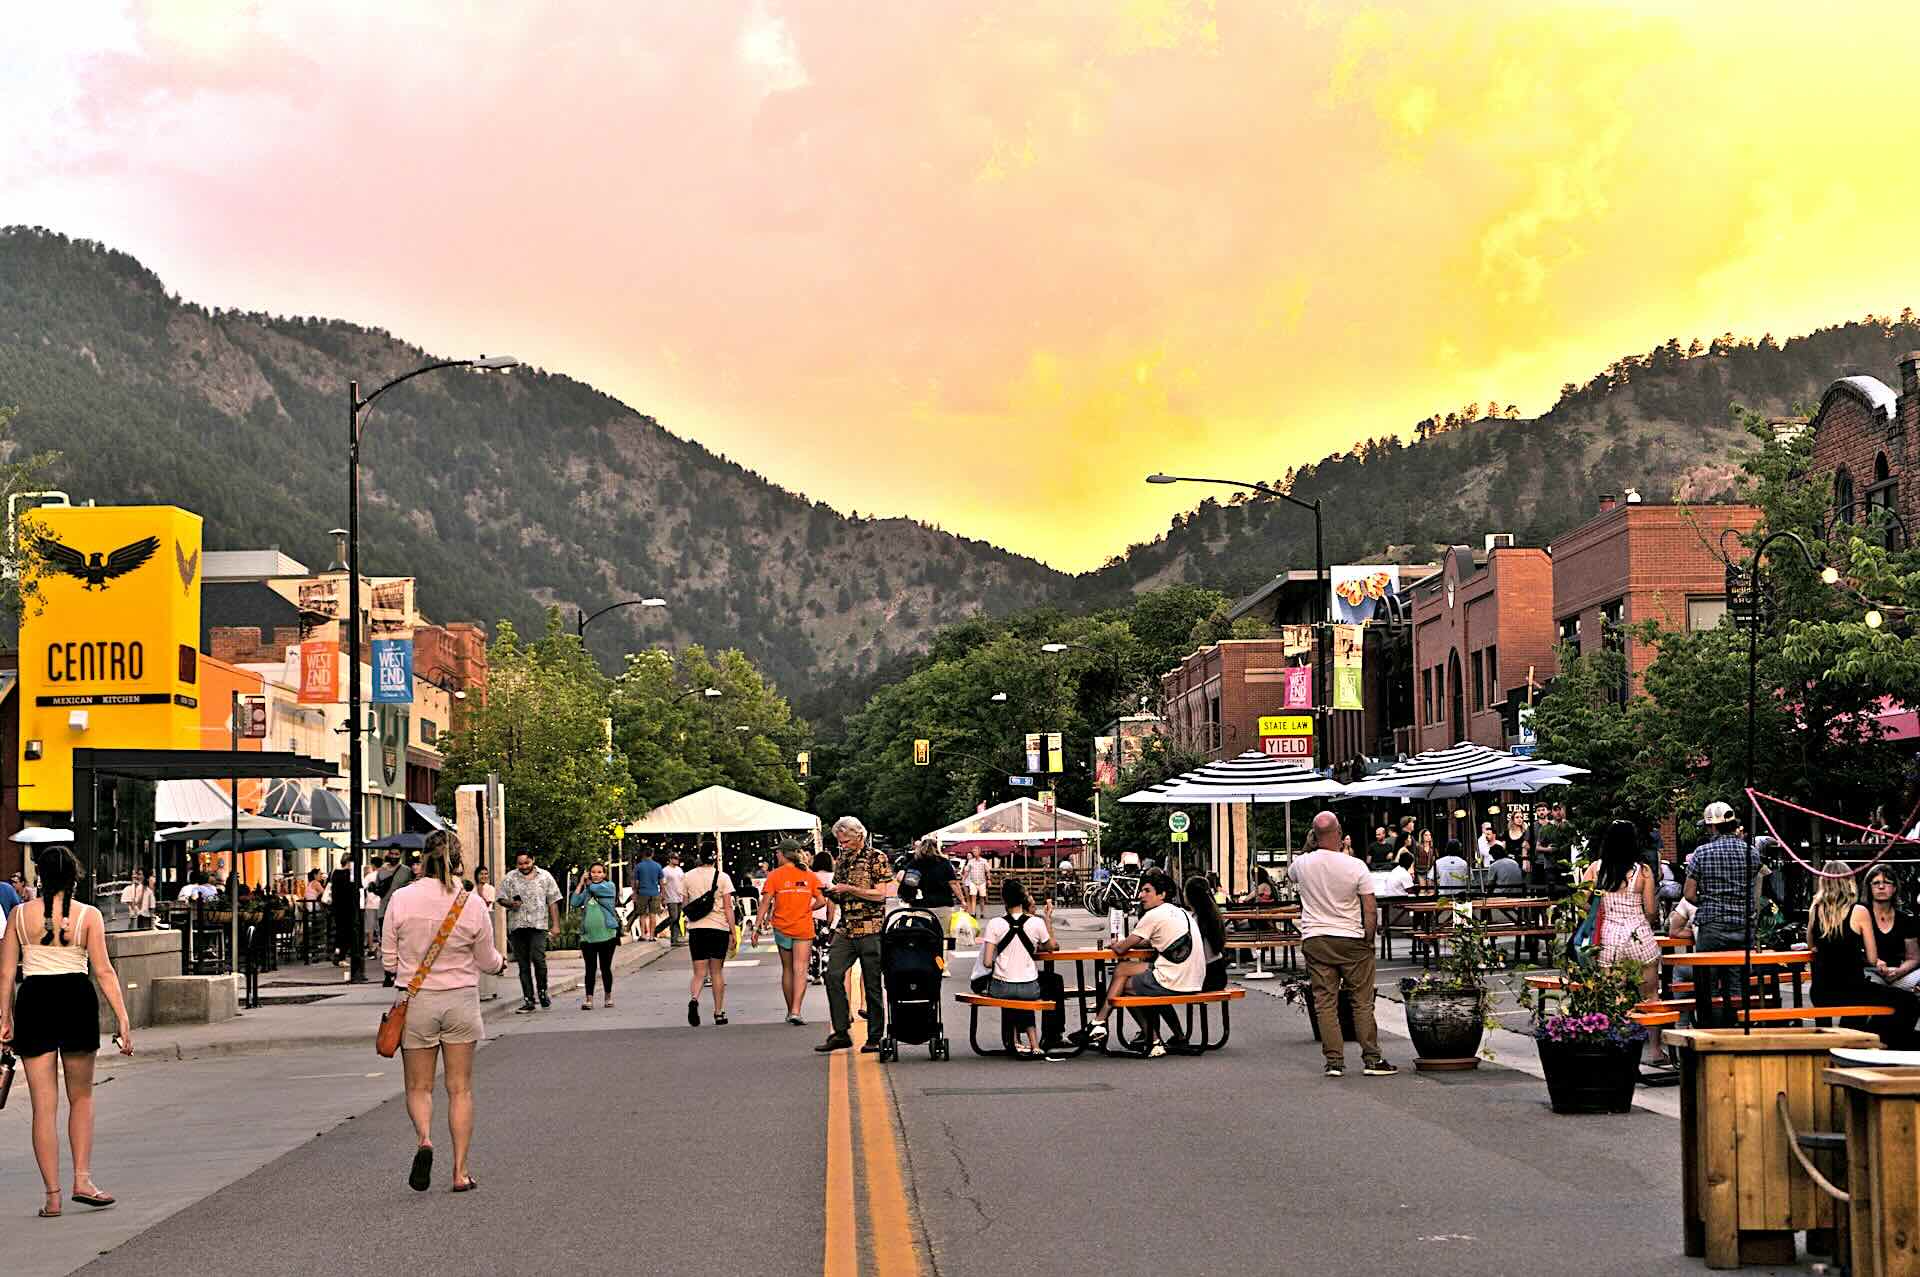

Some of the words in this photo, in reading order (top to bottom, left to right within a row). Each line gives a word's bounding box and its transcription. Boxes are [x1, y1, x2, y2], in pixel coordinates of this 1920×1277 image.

[48, 640, 143, 681] CENTRO
[306, 655, 330, 668] WEST
[379, 652, 405, 667] WEST
[307, 669, 330, 686] END
[380, 668, 405, 685] END
[52, 696, 93, 705] MEXICAN
[102, 695, 140, 704] KITCHEN
[1264, 721, 1287, 730] STATE
[1292, 721, 1308, 729] LAW
[1268, 740, 1306, 753] YIELD
